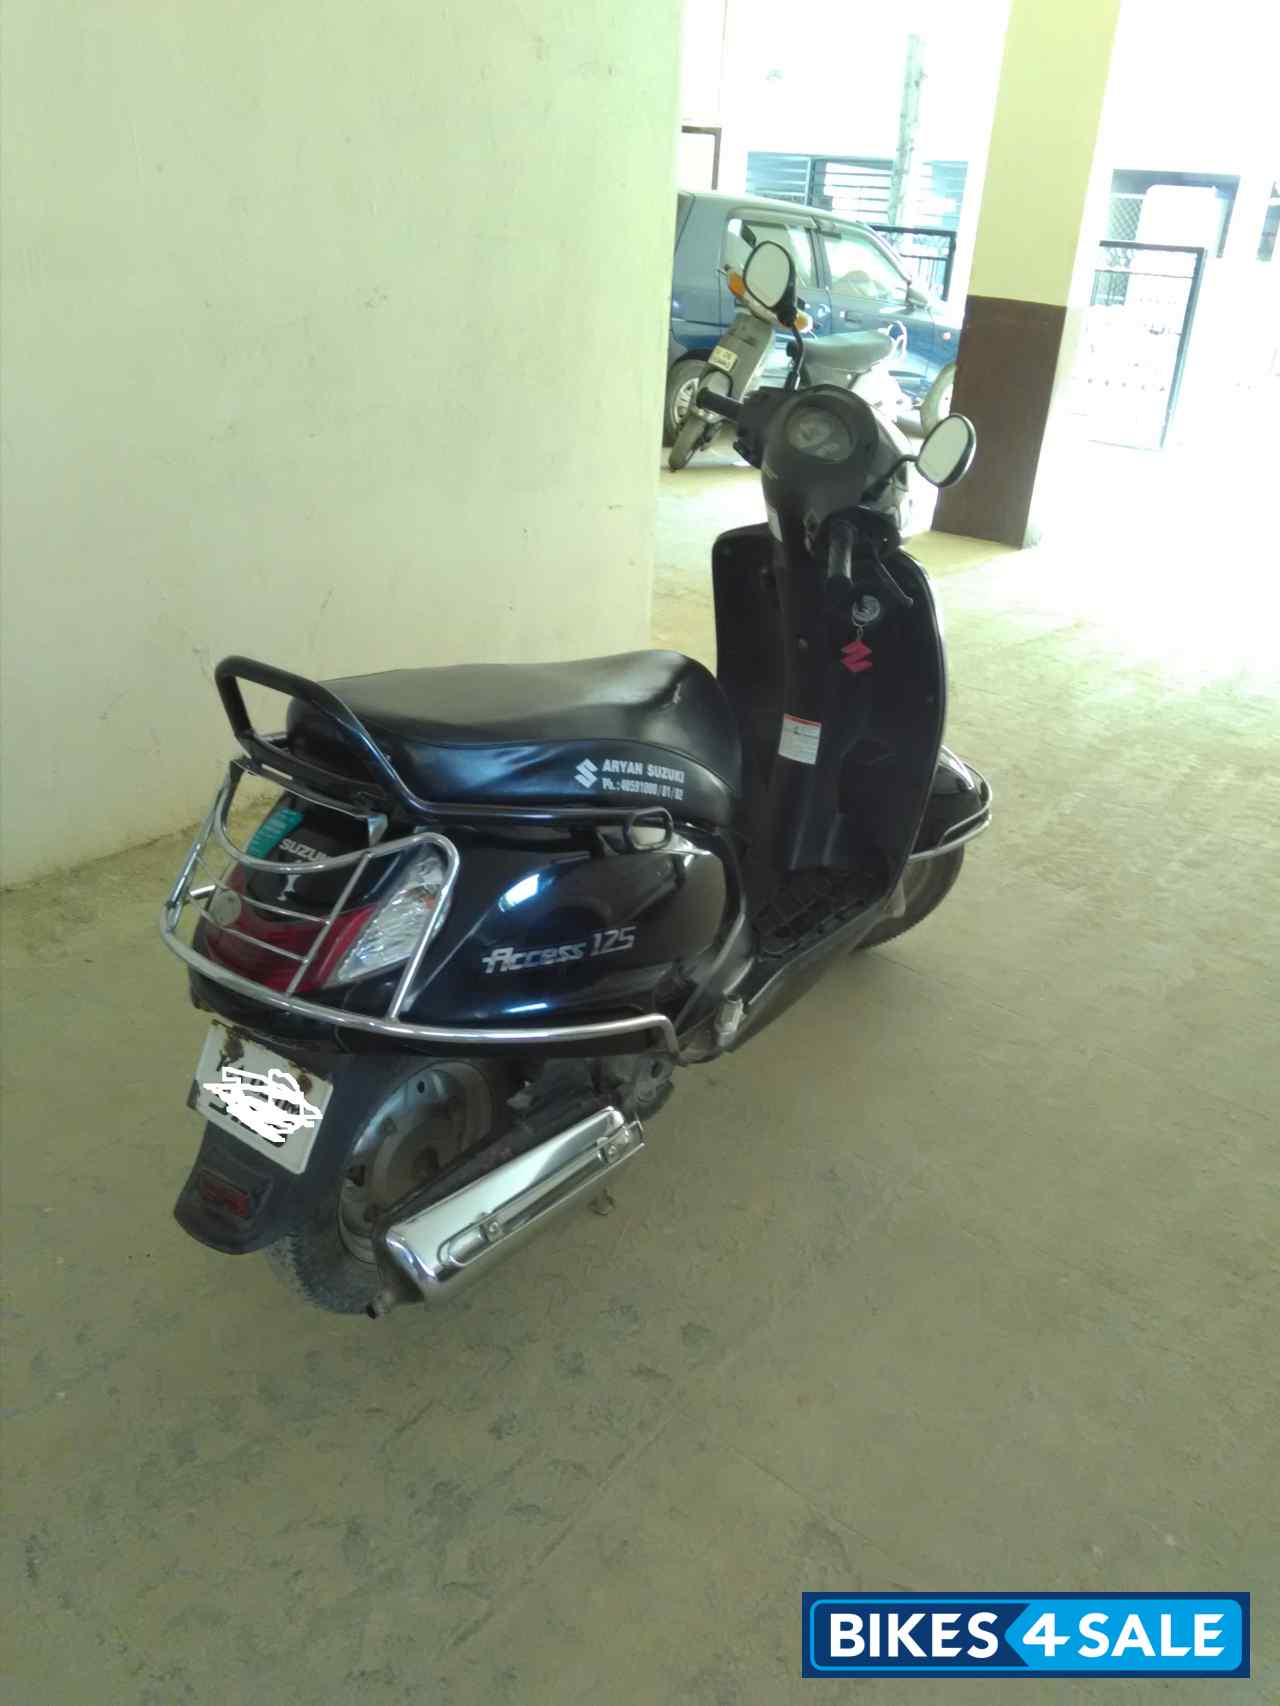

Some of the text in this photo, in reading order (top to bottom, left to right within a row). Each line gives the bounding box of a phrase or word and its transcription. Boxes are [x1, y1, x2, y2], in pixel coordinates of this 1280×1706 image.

[601, 759, 686, 784] ARYAN SUZUKI
[279, 838, 329, 861] SUZU
[482, 926, 637, 974] Access 125
